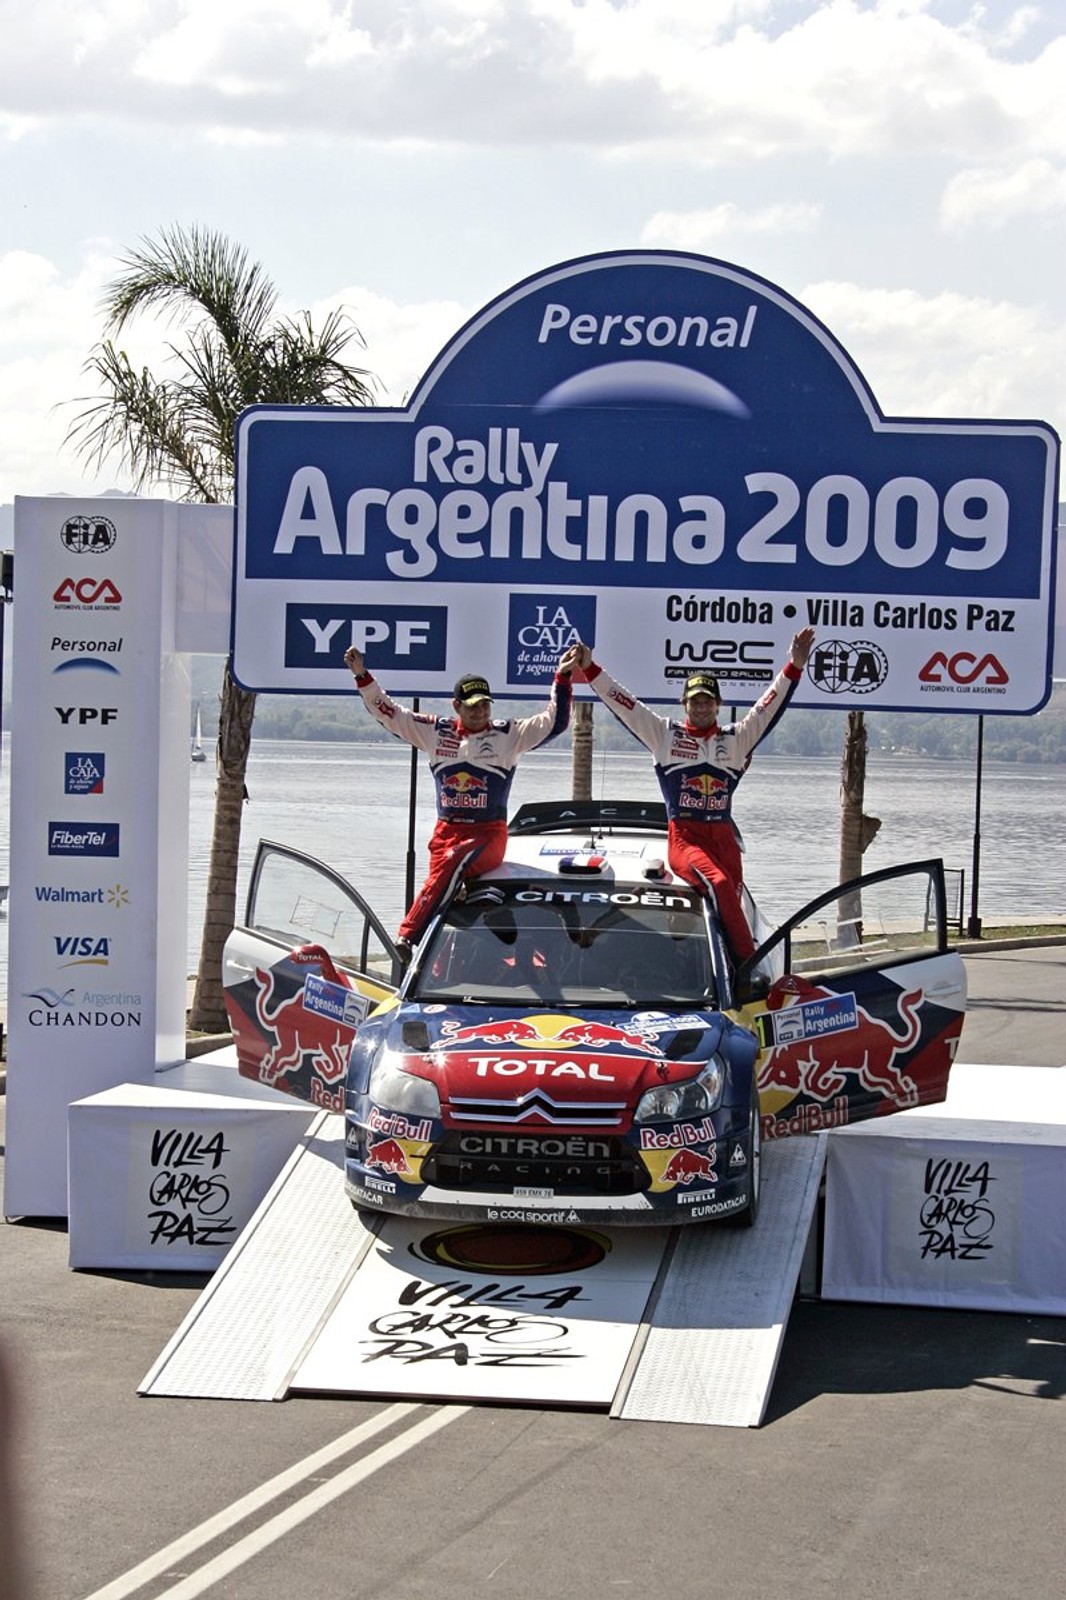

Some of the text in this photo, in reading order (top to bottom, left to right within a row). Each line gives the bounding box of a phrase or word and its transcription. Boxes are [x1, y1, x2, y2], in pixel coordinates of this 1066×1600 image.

[538, 303, 758, 348] Personal
[413, 425, 559, 497] Rally
[273, 465, 1010, 579] Argentina 2009
[53, 577, 123, 604] ACA
[535, 605, 572, 627] LA
[666, 594, 1016, 632] Córdoba Villa Carlos Paz
[51, 637, 123, 652] Personal
[300, 618, 431, 655] YPF
[518, 626, 583, 653] CAJA
[517, 650, 561, 662] de ahor
[665, 638, 775, 664] WRC
[516, 664, 525, 676] y
[730, 670, 771, 679] RALLY
[918, 651, 1010, 685] ACA
[920, 684, 1006, 695] AUTOMOVIL CLUB ARGENTINO
[54, 707, 118, 725] YPF
[69, 767, 100, 780] CAJA
[77, 757, 94, 768] LA
[461, 794, 487, 808] Bull
[679, 792, 706, 809] Red
[52, 831, 106, 845] FiberTel
[35, 887, 104, 903] Walmart
[54, 937, 110, 956] VISA
[82, 991, 141, 1006] Argentina
[305, 991, 344, 1016] Argentina
[805, 1005, 825, 1018] Rally
[28, 1010, 142, 1026] CHANDON
[805, 1011, 855, 1033] Argentina
[756, 1017, 766, 1048] 1
[468, 1056, 615, 1082] TOTAL
[310, 1076, 345, 1114] Red
[393, 1115, 433, 1142] Bull
[760, 1095, 849, 1140] Red Bull
[640, 1117, 716, 1150] Red Bull
[151, 1129, 231, 1170] VILLA
[365, 1176, 396, 1194] PIRELLI
[925, 1158, 998, 1198] VILLA
[149, 1171, 230, 1215] CARLOS
[677, 1188, 715, 1204] PIRELLI
[691, 1194, 746, 1217] EURODATACAR
[148, 1211, 237, 1245] PAZ
[487, 1208, 565, 1223] le coq sportif
[920, 1195, 995, 1238] CARLOS
[919, 1229, 994, 1260] PAZ
[399, 1280, 594, 1309] VILLA
[368, 1311, 569, 1343] CARLOS
[358, 1339, 587, 1367] PAZ
